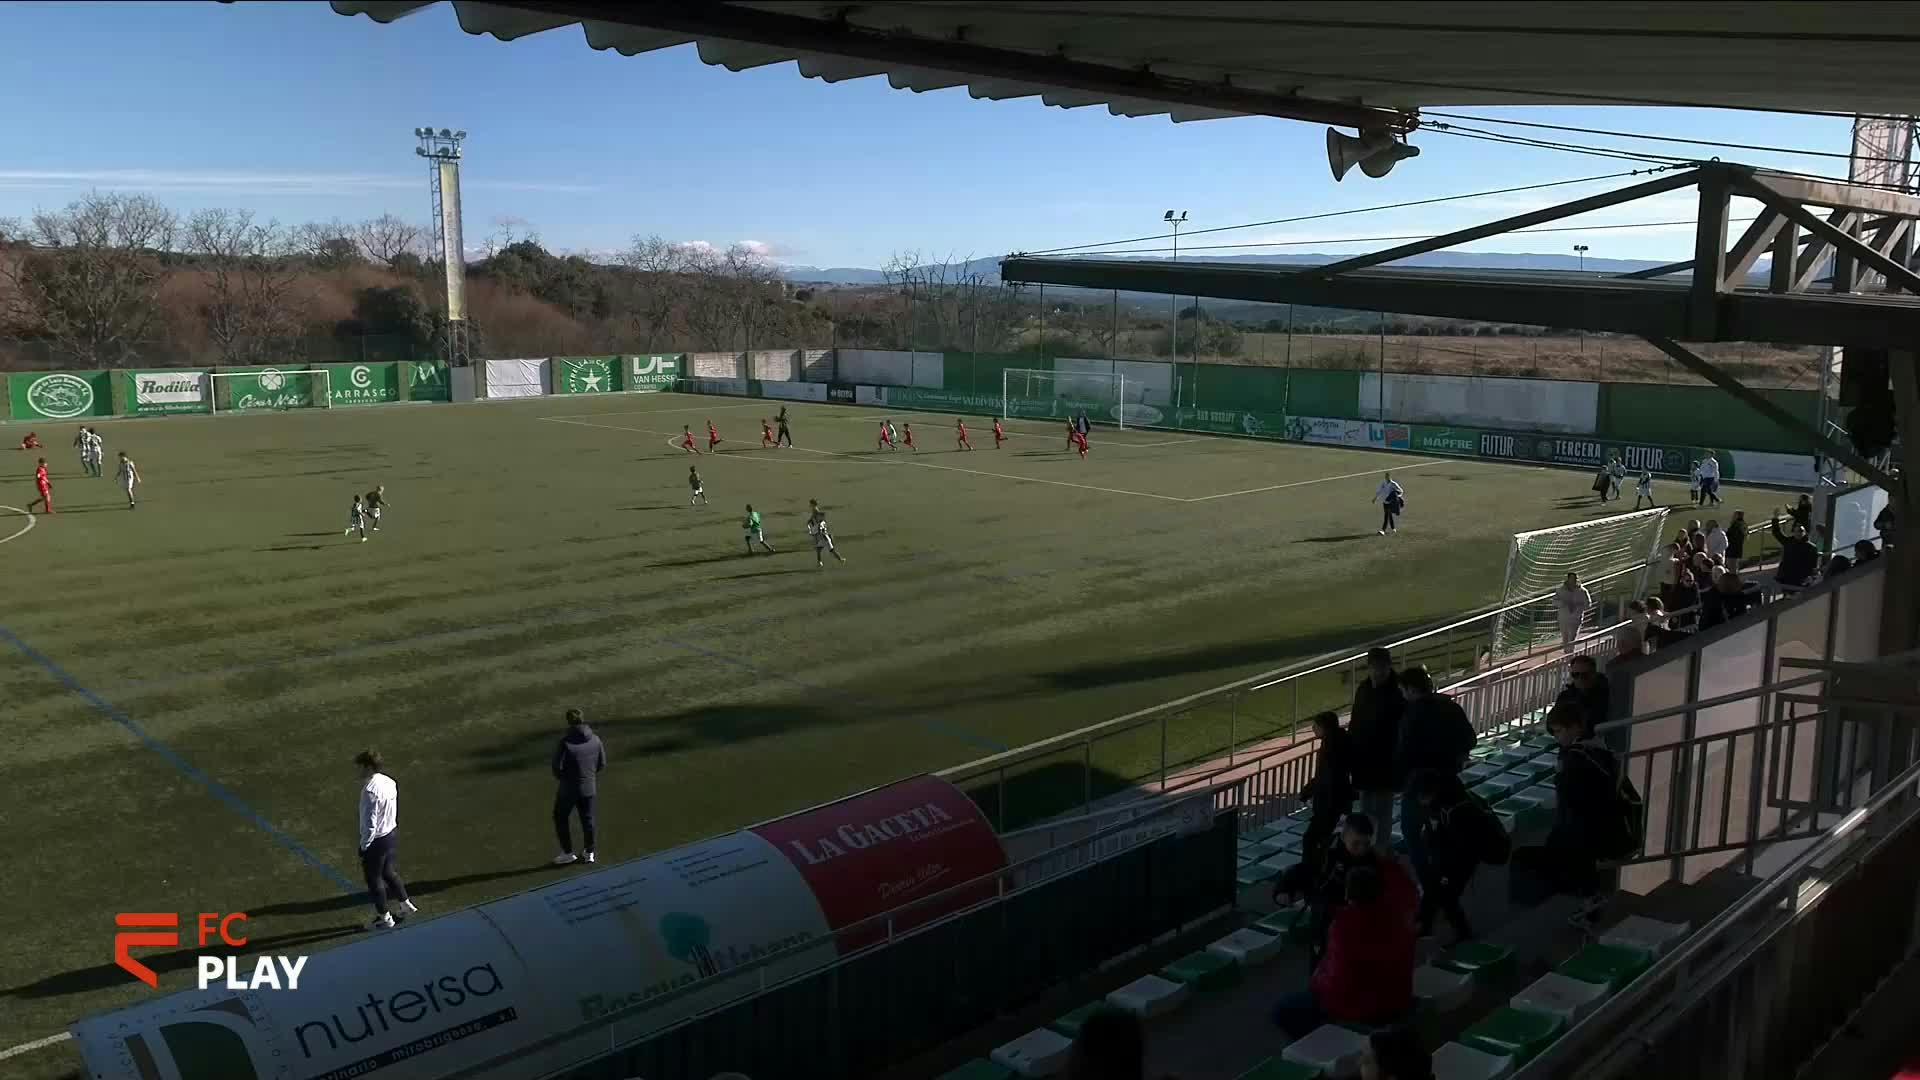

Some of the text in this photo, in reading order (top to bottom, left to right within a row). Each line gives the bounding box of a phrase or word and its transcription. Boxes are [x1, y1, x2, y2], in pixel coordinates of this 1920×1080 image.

[633, 375, 650, 384] VAN
[142, 380, 201, 394] Rodilla
[326, 387, 396, 399] CARRASCO
[1423, 437, 1473, 450] MAPFRE
[1555, 440, 1601, 458] TERCERA
[789, 818, 848, 864] LA
[837, 802, 952, 849] GACETA
[294, 961, 504, 1059] nutersa
